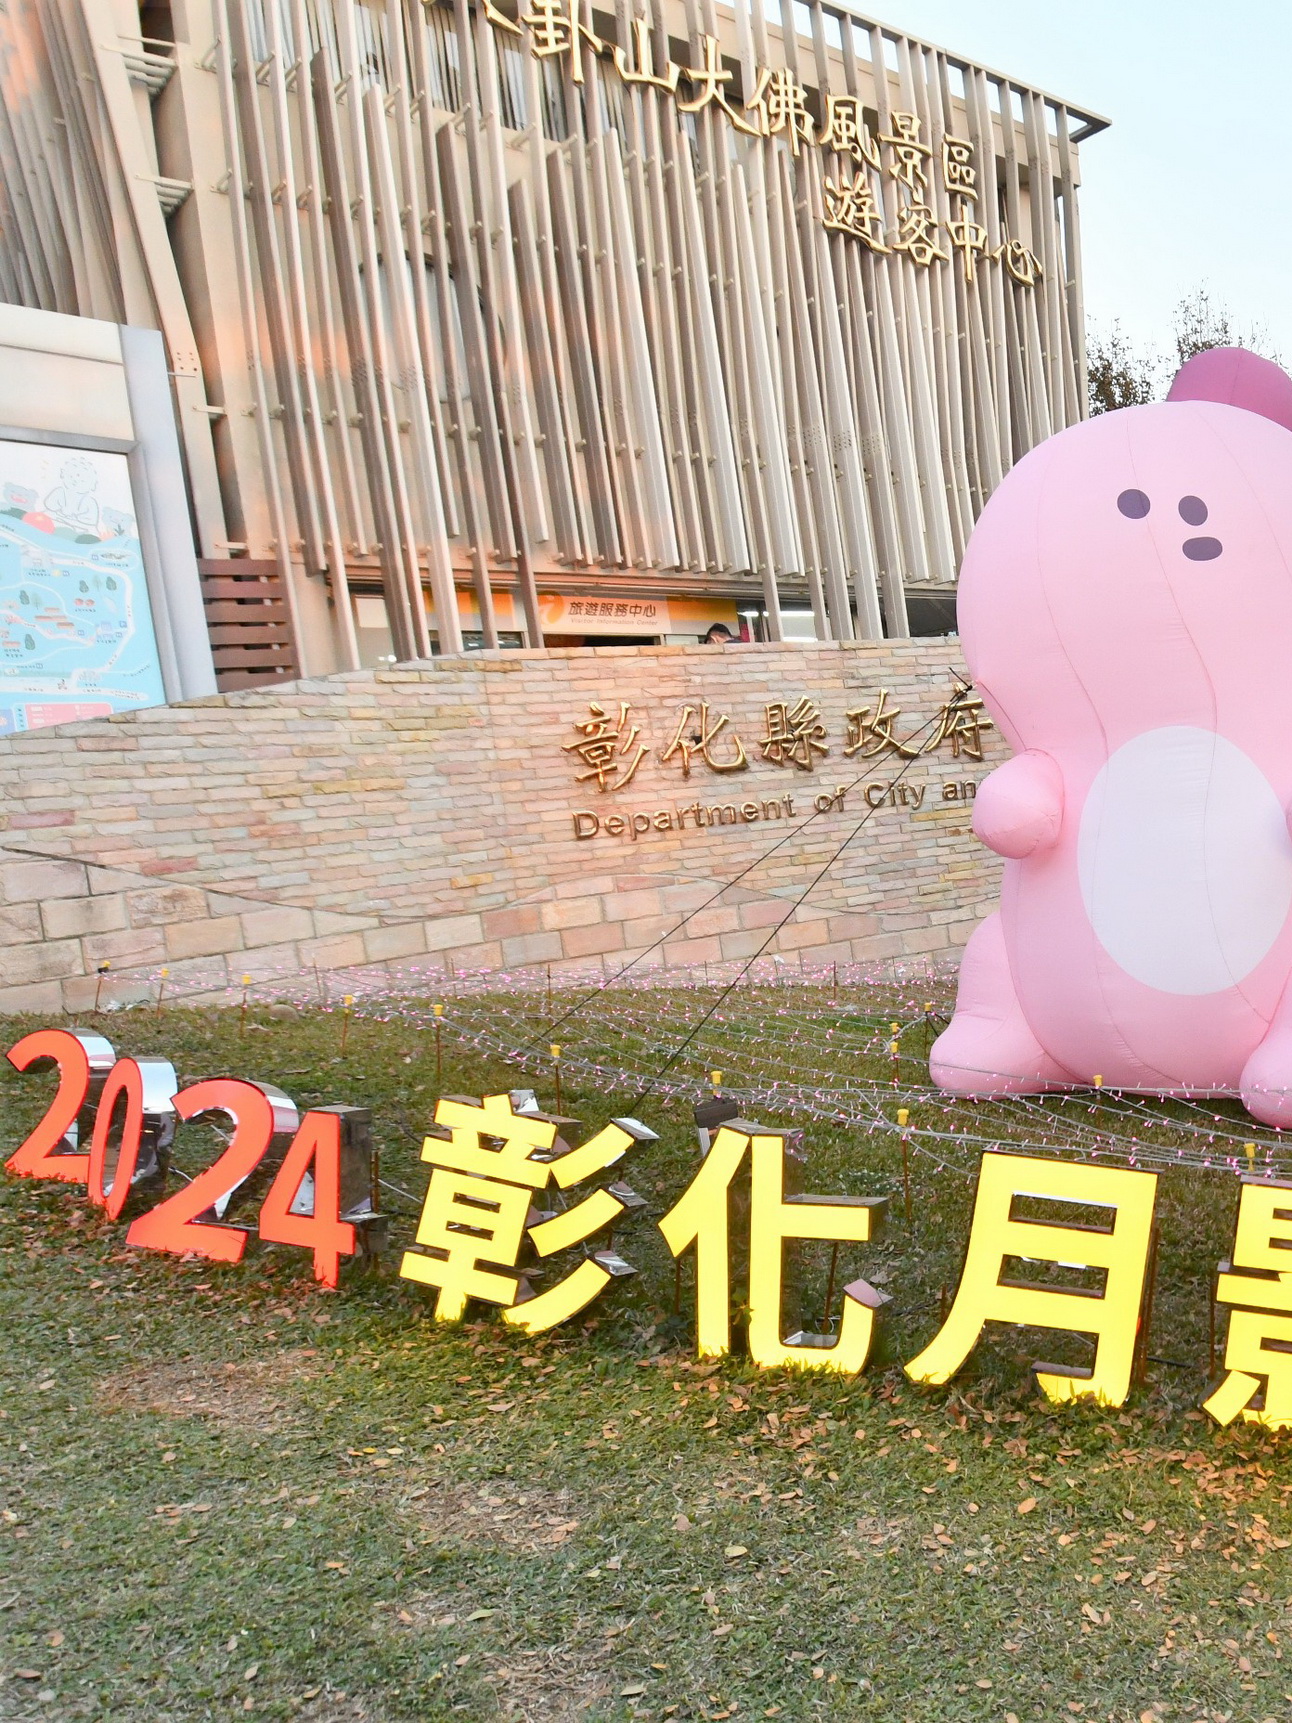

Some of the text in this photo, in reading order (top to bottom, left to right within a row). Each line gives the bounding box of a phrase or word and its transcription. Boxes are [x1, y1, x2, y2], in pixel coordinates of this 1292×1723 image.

[822, 175, 1043, 287] 遊客中心
[568, 601, 657, 618] 旅遊服務中心
[562, 683, 994, 793] 彰化縣政府
[572, 792, 797, 841] Department
[813, 785, 847, 814] of
[863, 779, 926, 811] City
[942, 779, 977, 801] an
[5, 1027, 357, 1290] 2024
